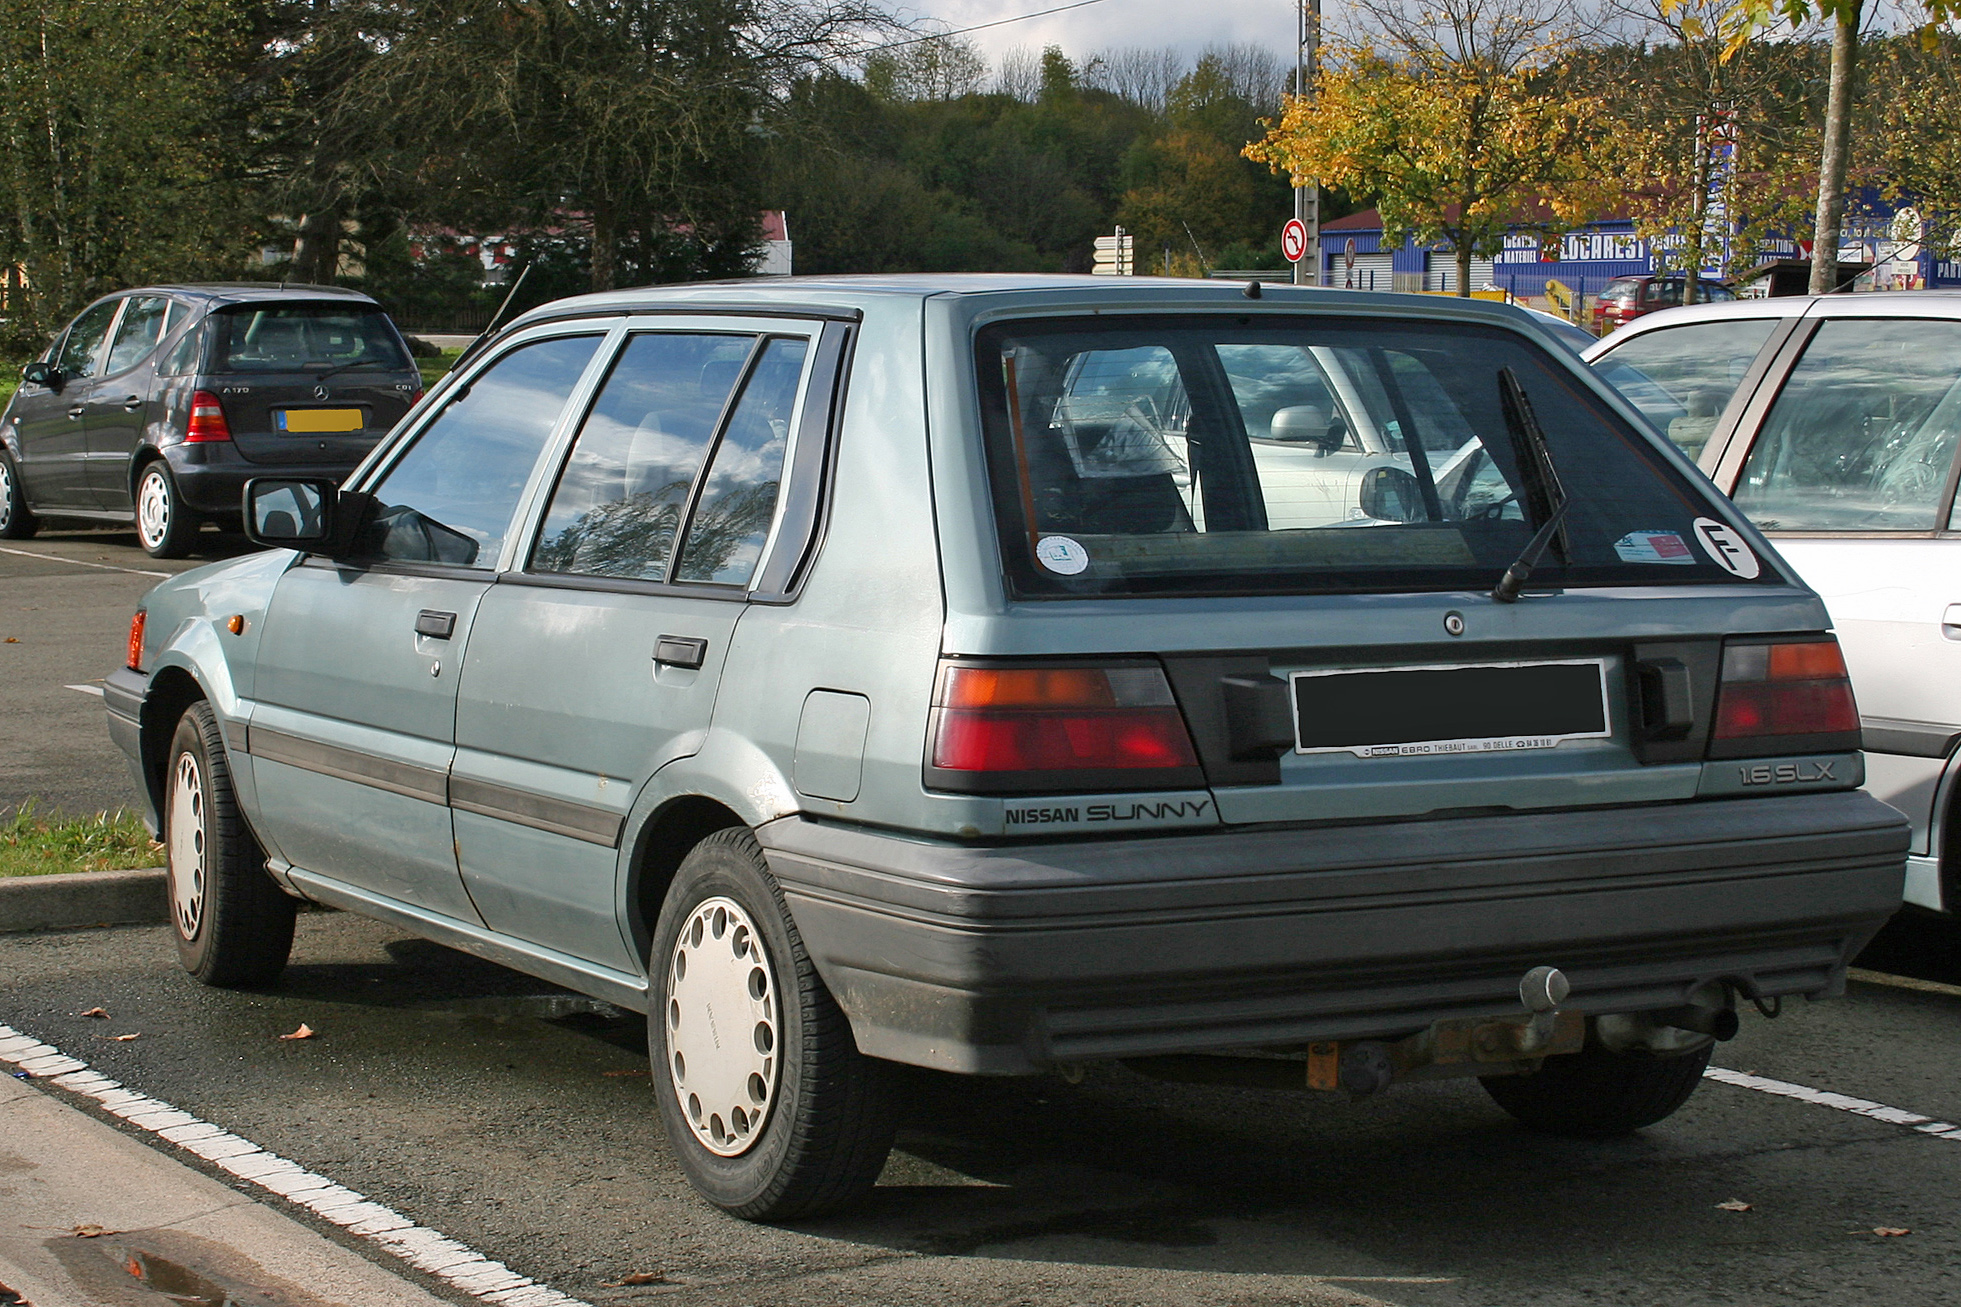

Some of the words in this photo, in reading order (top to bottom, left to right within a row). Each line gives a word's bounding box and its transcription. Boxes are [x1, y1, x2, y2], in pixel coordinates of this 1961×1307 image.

[1503, 250, 1537, 263] MATERIEL
[1699, 525, 1740, 571] F
[1402, 745, 1430, 754] EBRO
[1434, 743, 1466, 752] THIEBAUT
[1493, 740, 1512, 749] DELLE
[1740, 765, 1771, 785] 1.6
[1775, 762, 1837, 783] SLX
[1006, 808, 1079, 824] NISSAN
[1087, 800, 1209, 822] SUNNY
